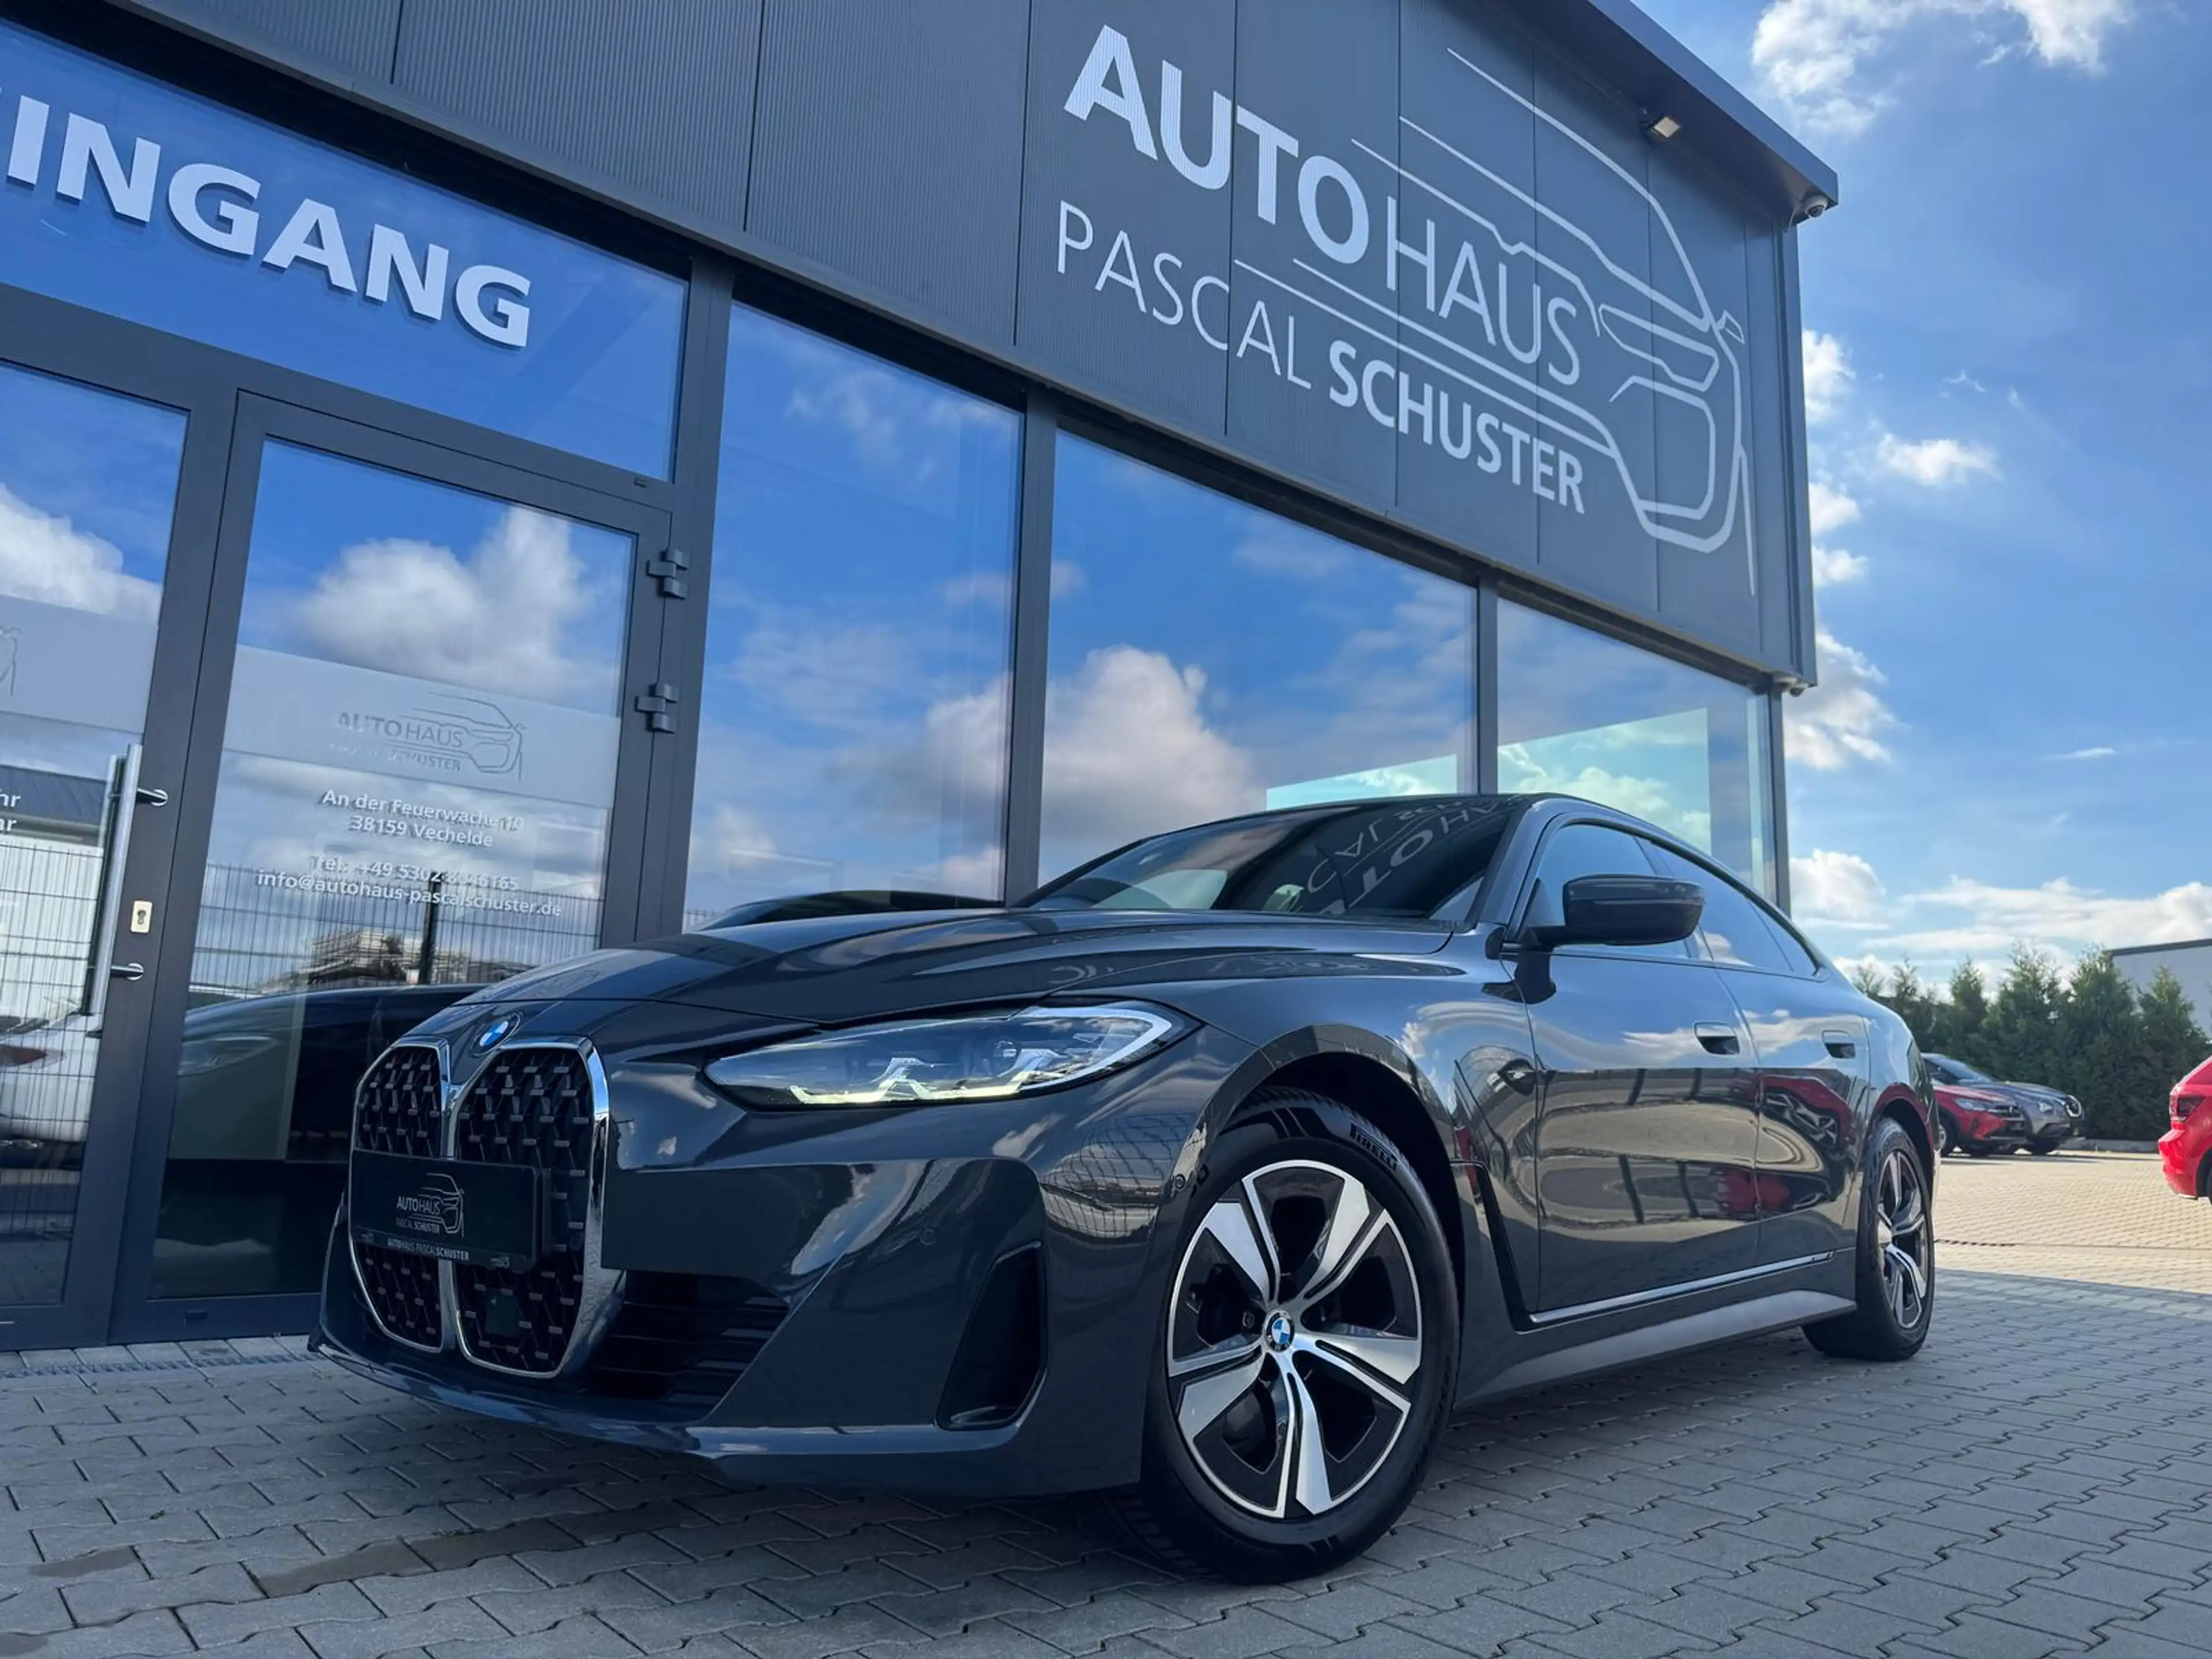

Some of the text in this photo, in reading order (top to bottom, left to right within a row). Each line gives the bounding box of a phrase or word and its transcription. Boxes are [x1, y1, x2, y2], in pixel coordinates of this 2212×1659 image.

[0, 86, 532, 347] INGANG
[1064, 25, 1580, 386] AUTOHAUS
[1058, 200, 1585, 514] PASCAL SCHUSTER
[321, 790, 350, 806] An
[355, 794, 388, 812] der
[391, 799, 500, 826] Feuerwache
[351, 815, 494, 847] 38159 Vechelde
[396, 1196, 441, 1215] AUTOHAUS
